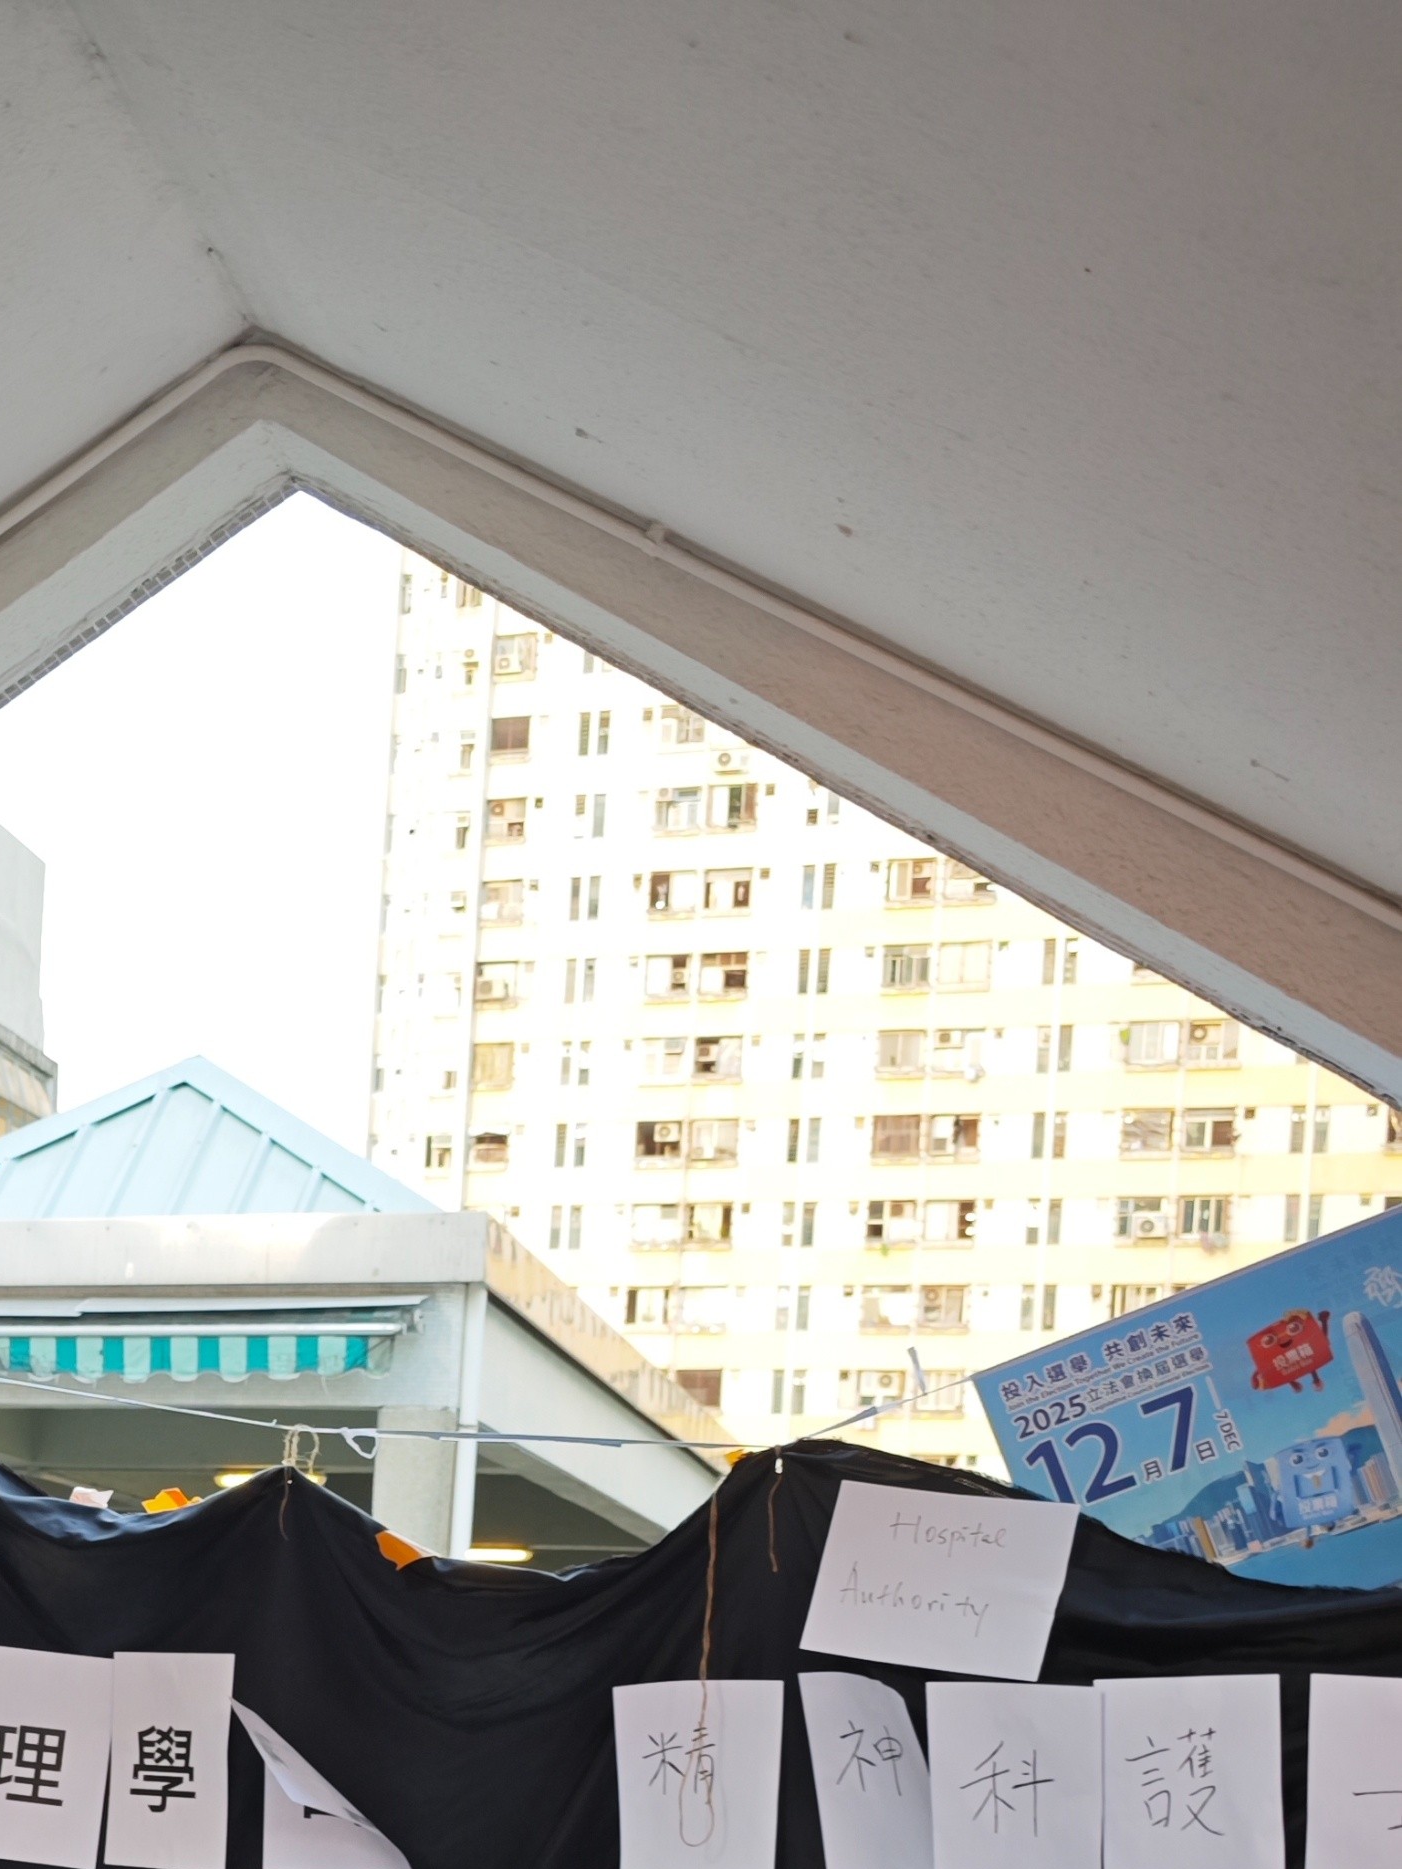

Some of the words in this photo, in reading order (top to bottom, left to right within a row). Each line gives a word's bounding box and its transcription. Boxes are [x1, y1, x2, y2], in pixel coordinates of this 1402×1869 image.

[1002, 1355, 1088, 1400] 投入選舉
[1104, 1314, 1193, 1361] 共創未來
[1220, 1422, 1241, 1451] DEC
[889, 1511, 1008, 1558] Hospital
[840, 1560, 988, 1638] Authority
